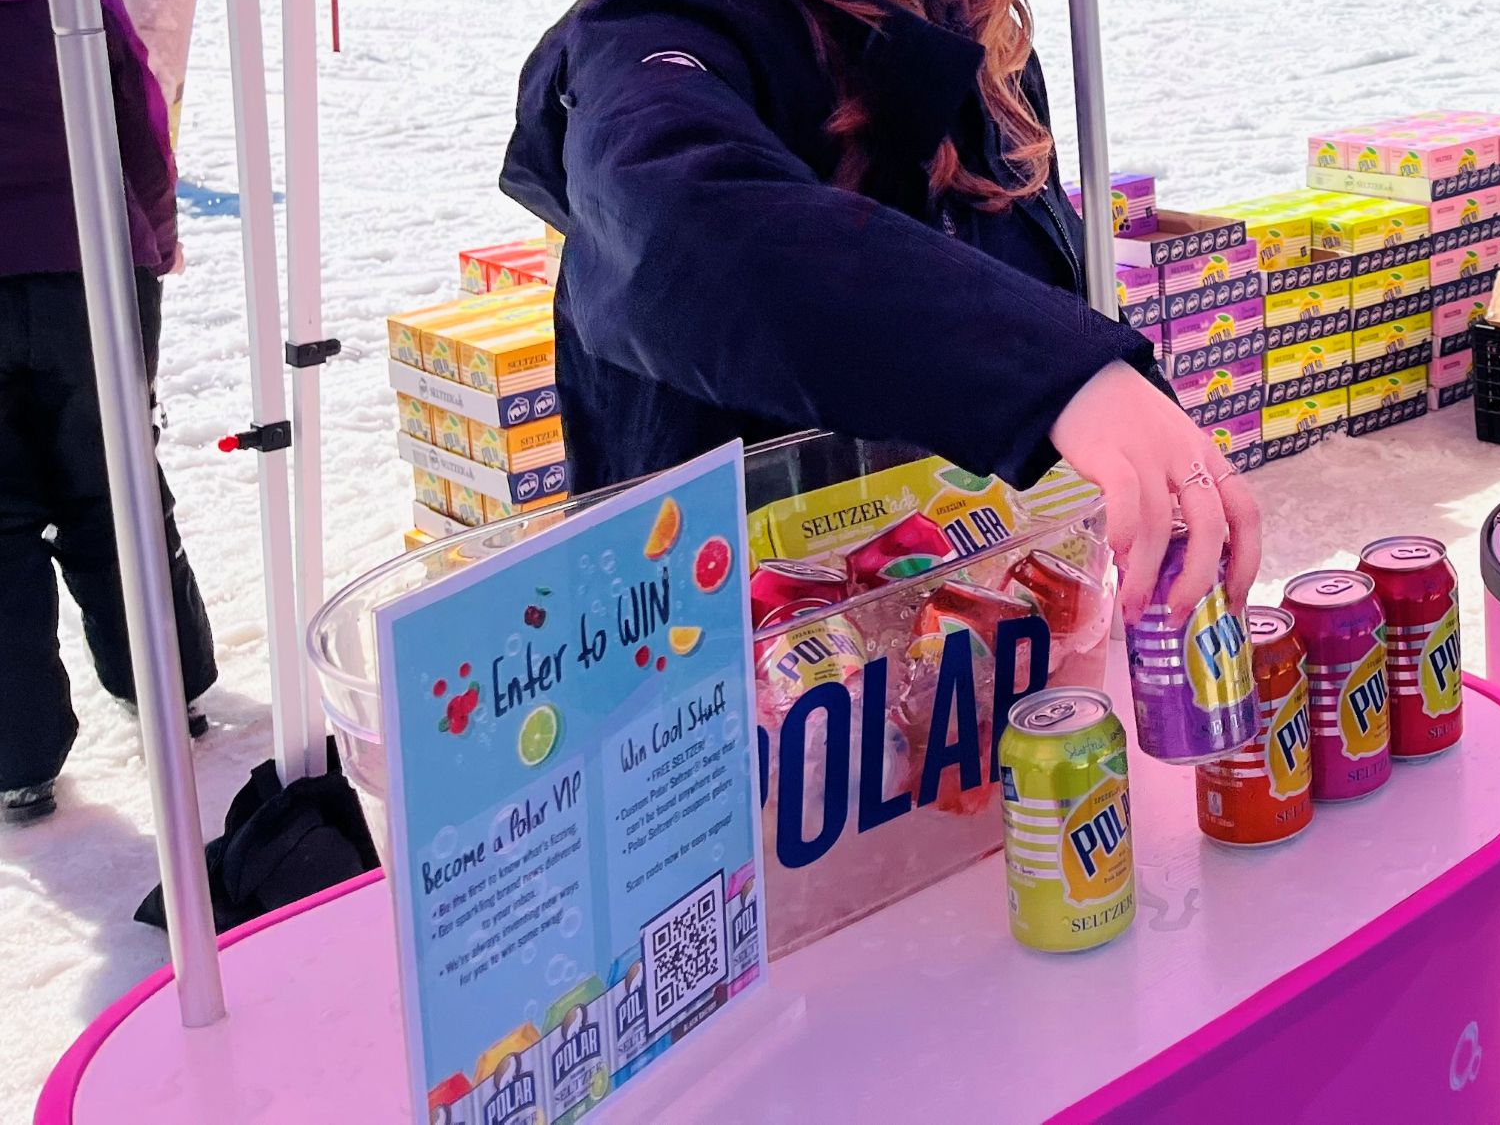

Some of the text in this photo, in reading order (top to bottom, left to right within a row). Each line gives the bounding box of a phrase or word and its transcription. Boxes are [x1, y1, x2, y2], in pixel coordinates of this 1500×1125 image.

[507, 352, 548, 370] SELTZER
[519, 429, 560, 447] SELTZER
[492, 565, 671, 718] Enter to WIN
[620, 681, 726, 773] Win Cool Stuff
[757, 615, 1051, 869] OLAR
[620, 795, 649, 821] Custom
[650, 782, 668, 803] Polar
[703, 748, 721, 769] Swag
[722, 740, 736, 755] that
[652, 762, 671, 781] FREE
[422, 770, 581, 895] Become a Polar VIP
[626, 814, 643, 836] can't
[646, 809, 655, 823] be
[656, 796, 677, 817] found
[678, 773, 711, 805] anywhere
[628, 834, 646, 854] Polar
[682, 790, 711, 818] coupons
[438, 837, 581, 939] Get sparkling brand news delivered
[439, 901, 452, 917] Be
[453, 893, 467, 908] the
[468, 879, 485, 898] first
[488, 874, 497, 886] to
[499, 860, 521, 880] know
[523, 841, 549, 864] what's
[626, 877, 645, 893] Scan
[647, 860, 664, 880] code
[664, 849, 679, 867] now
[680, 839, 691, 855] for
[691, 829, 708, 850] easy
[445, 881, 579, 973] We're always inventing new ways
[481, 919, 490, 930] to
[493, 906, 511, 926] your
[1071, 892, 1134, 934] SELTZER
[459, 973, 471, 987] for
[473, 961, 488, 980] you
[490, 954, 499, 964] to
[501, 942, 519, 958] win
[518, 927, 539, 948] some
[554, 1027, 599, 1082] POLAR
[486, 1078, 534, 1125] POLAR
